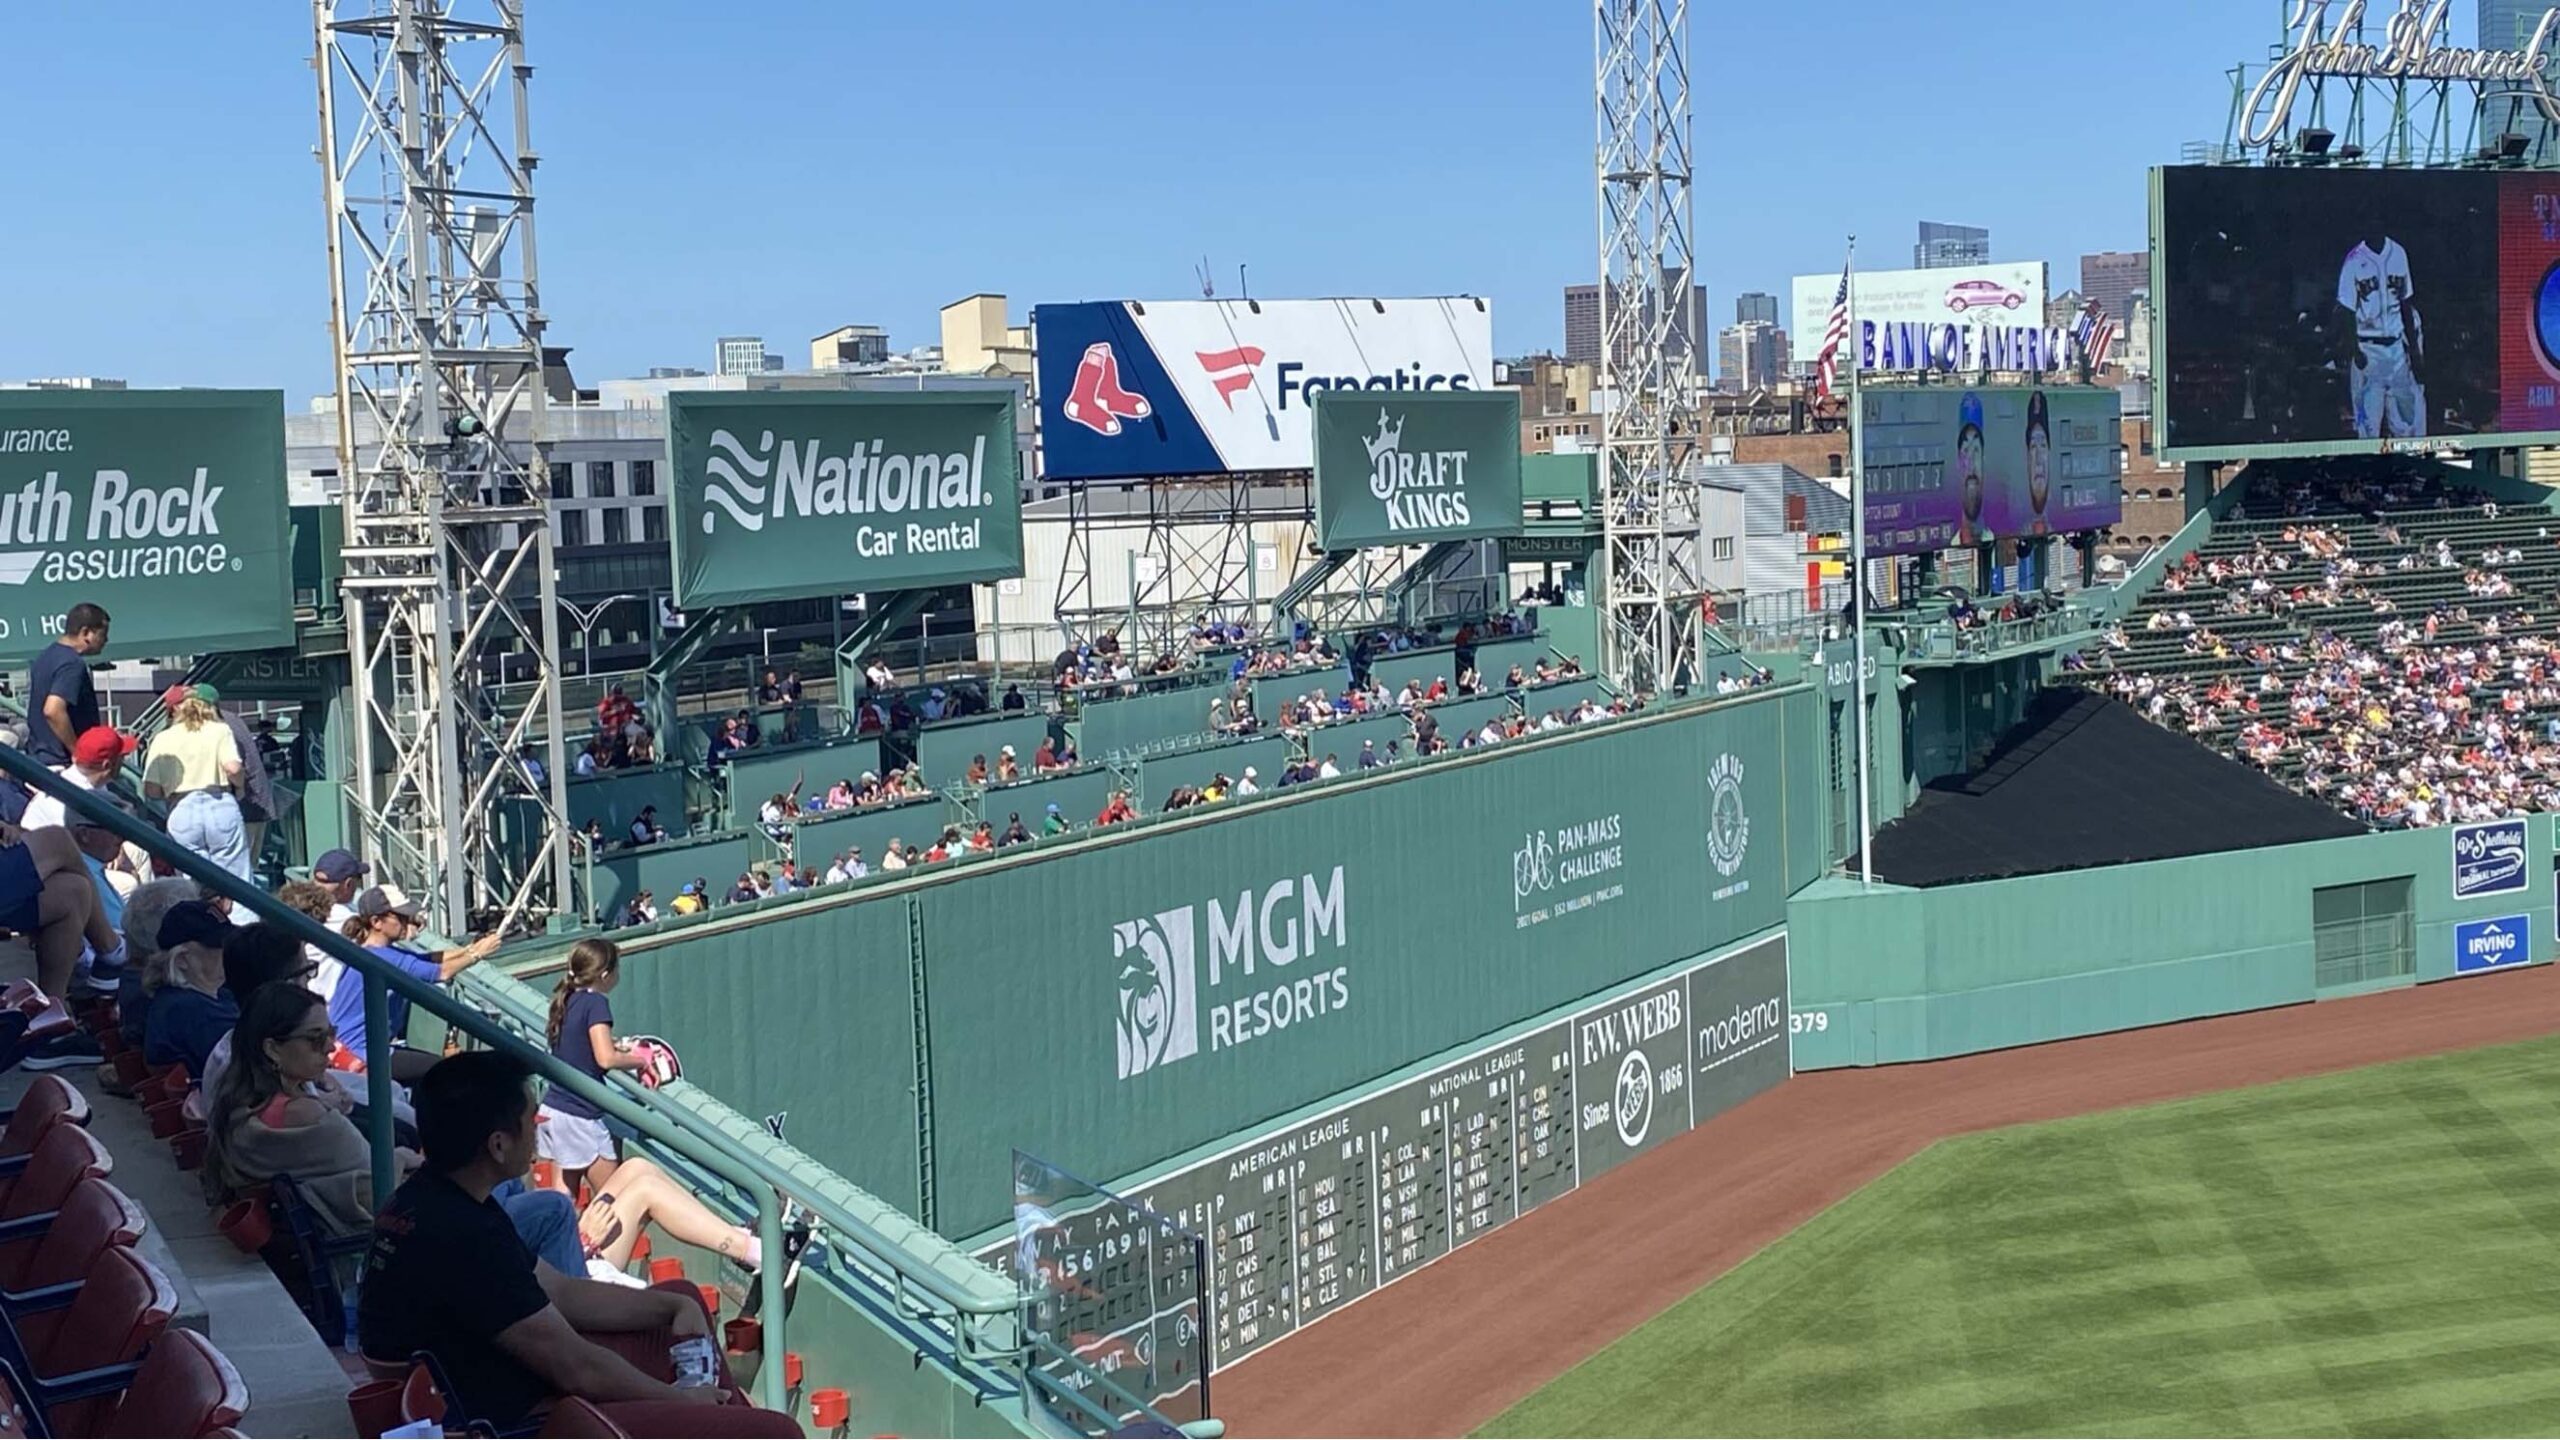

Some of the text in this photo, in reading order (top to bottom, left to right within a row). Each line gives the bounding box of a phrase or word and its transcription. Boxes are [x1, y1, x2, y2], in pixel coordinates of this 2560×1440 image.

[1862, 320, 2074, 372] BANK OF AMERICA
[773, 435, 986, 518] National
[1369, 449, 1469, 500] DRAFT
[86, 468, 224, 541] Rock
[1387, 490, 1471, 531] KINGS
[857, 517, 981, 558] Car Rental
[1506, 538, 1583, 551] MONSTER
[1827, 657, 1876, 686] ABIOED
[1558, 814, 1622, 854] PAN-MASS
[1560, 845, 1624, 884] CHALLENGE
[1207, 865, 1346, 986] MGM
[2468, 933, 2516, 954] IRVING
[1210, 966, 1349, 1052] RESORTS
[1622, 988, 1682, 1047] WEBB
[1699, 997, 1780, 1059] moderna
[1790, 1012, 1828, 1034] 379
[1429, 1048, 1525, 1099] NATIONAL LEAGUE
[1519, 1070, 1526, 1087] P
[1453, 1097, 1460, 1114] P
[1500, 1076, 1508, 1094] R
[1583, 1063, 1684, 1131] Since 1866
[1467, 1113, 1484, 1132] LAD
[1532, 1103, 1550, 1123] CHC
[1382, 1126, 1389, 1144] P
[1433, 1106, 1440, 1122] R
[1534, 1123, 1549, 1142] OAK
[1229, 1118, 1350, 1181] AMERICAN LEAGUE
[1398, 1143, 1416, 1162] COL
[1471, 1132, 1483, 1150] SF
[1298, 1160, 1306, 1179] P
[1356, 1136, 1364, 1153] R
[1469, 1151, 1486, 1171] ATL
[1399, 1163, 1416, 1183] LAA
[1469, 1171, 1488, 1191] NYM
[1217, 1171, 1286, 1213] P IN R
[1314, 1176, 1335, 1201] HOU
[1399, 1183, 1418, 1204] WSH
[1316, 1198, 1336, 1218] SEA
[1472, 1191, 1487, 1210] ARI
[1235, 1211, 1256, 1234] NYY
[1401, 1203, 1417, 1224] PHI
[1471, 1209, 1488, 1229] TEX
[1066, 1254, 1078, 1276] 5
[1082, 1250, 1093, 1272] 6
[1106, 1239, 1117, 1260] 8
[1120, 1233, 1131, 1254] 9
[1195, 1203, 1203, 1223] E
[1317, 1220, 1336, 1241] MIA
[1401, 1224, 1418, 1244] MIL
[1239, 1234, 1254, 1255] TB
[1317, 1241, 1337, 1263] BAL
[1402, 1244, 1418, 1264] PIT
[1235, 1255, 1258, 1279] CWS
[1318, 1263, 1337, 1284] STL
[1240, 1279, 1255, 1299] KC
[1319, 1283, 1339, 1306] CLE
[1238, 1300, 1258, 1324] DET
[1240, 1323, 1259, 1345] MIN
